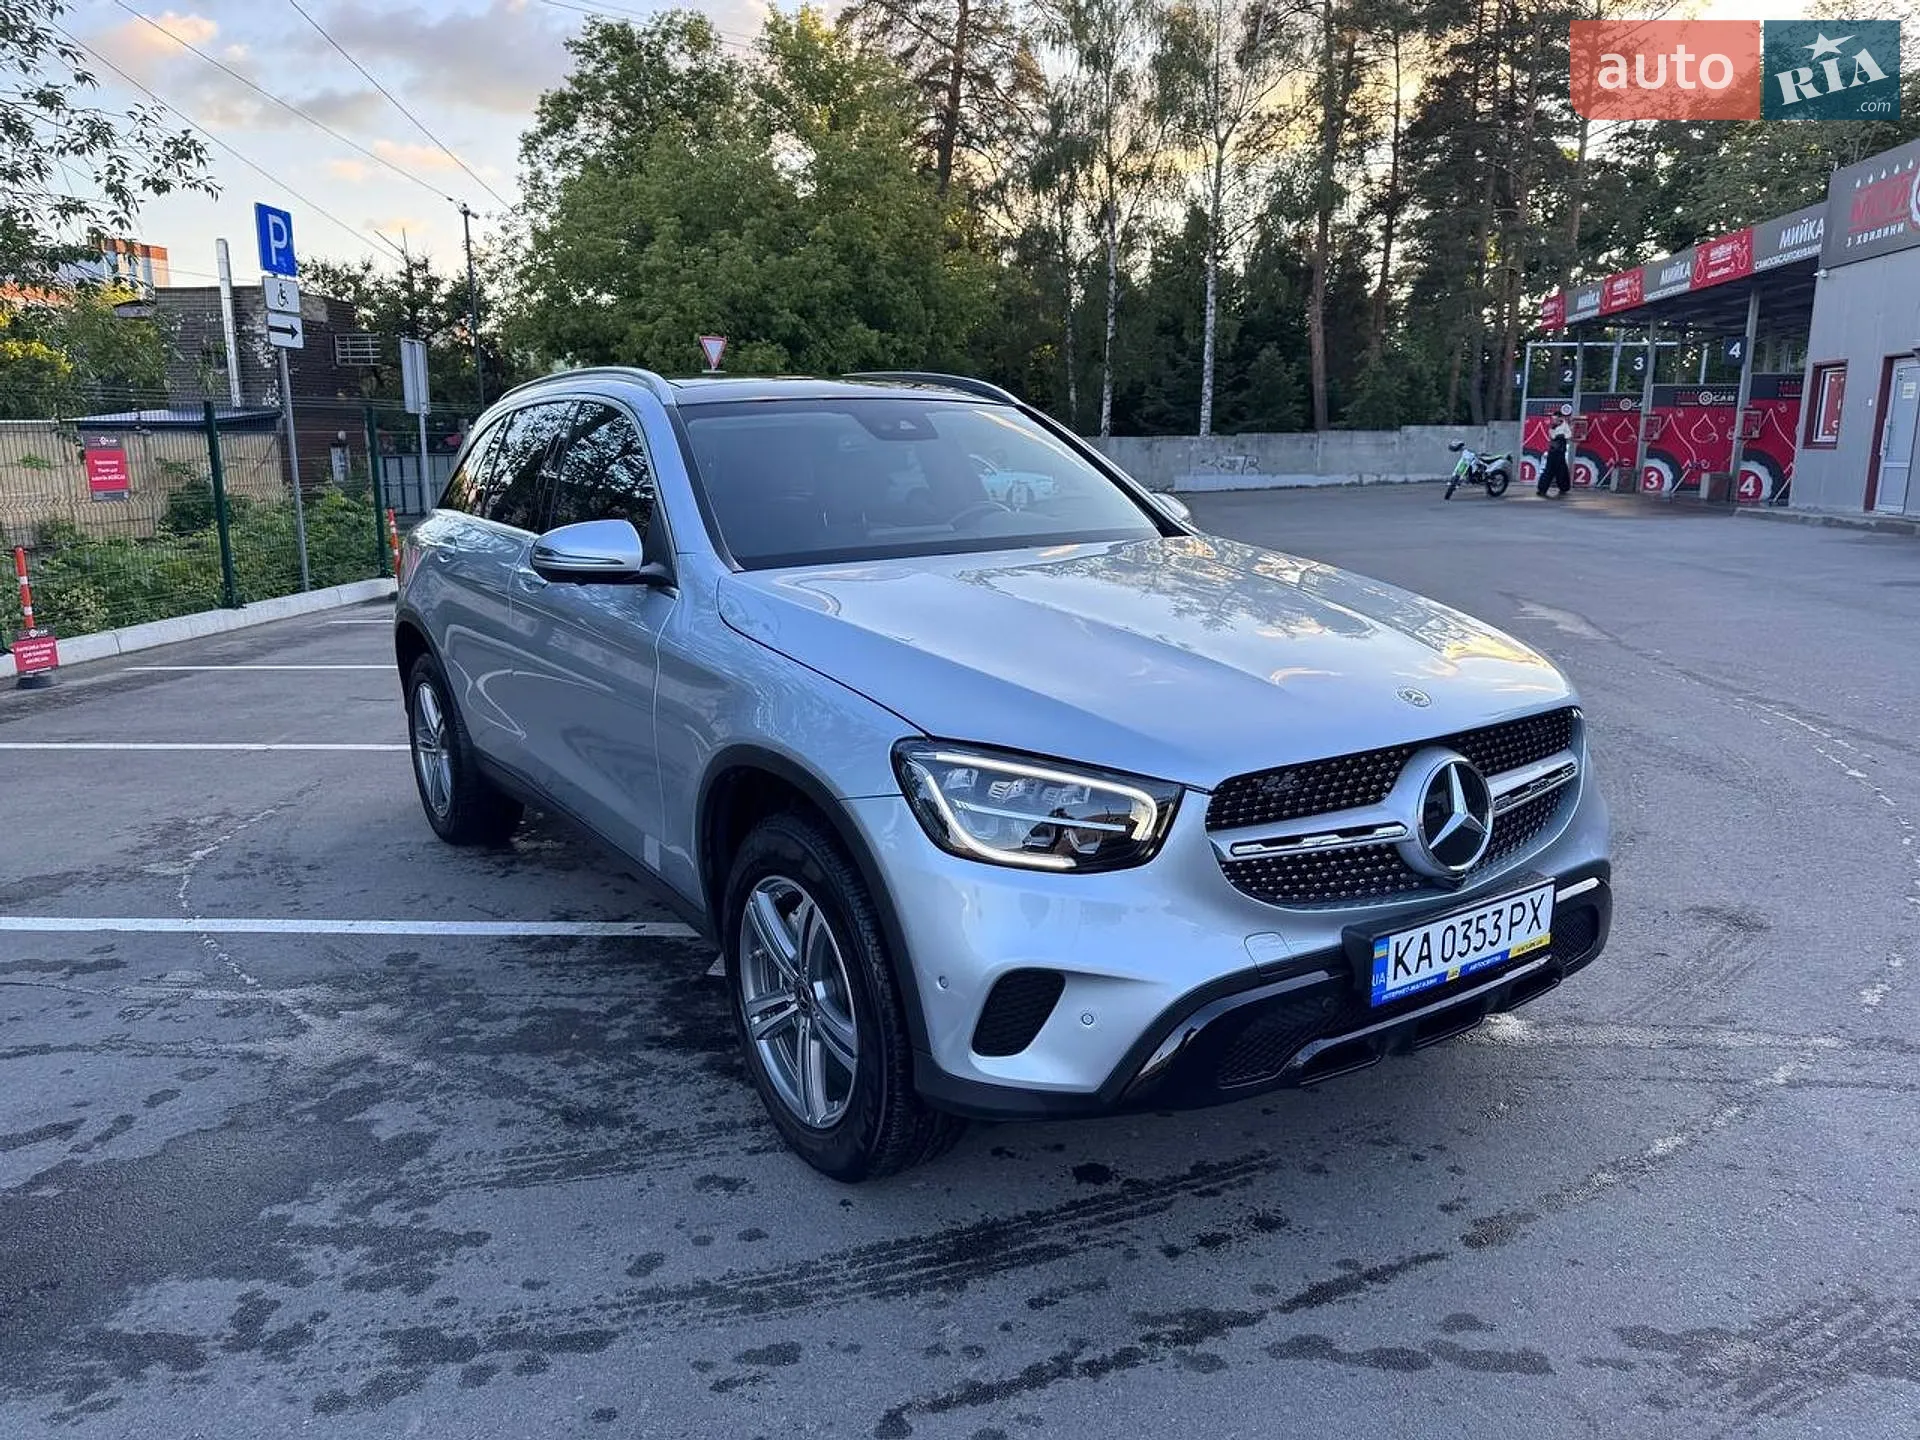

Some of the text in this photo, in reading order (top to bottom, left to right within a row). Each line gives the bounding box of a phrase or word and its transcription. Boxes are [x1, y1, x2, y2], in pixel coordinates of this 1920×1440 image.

[267, 213, 288, 266] P
[1779, 217, 1824, 250] МИЙКА
[1729, 341, 1742, 359] 4
[1633, 356, 1644, 370] 3
[1514, 373, 1522, 385] 1
[1563, 369, 1573, 383] 2
[1523, 464, 1532, 479] 1
[1575, 467, 1588, 484] 2
[1645, 470, 1660, 489] 3
[1740, 475, 1757, 496] 4
[1393, 893, 1546, 981] KA 0353 PX
[1372, 972, 1387, 988] UA
